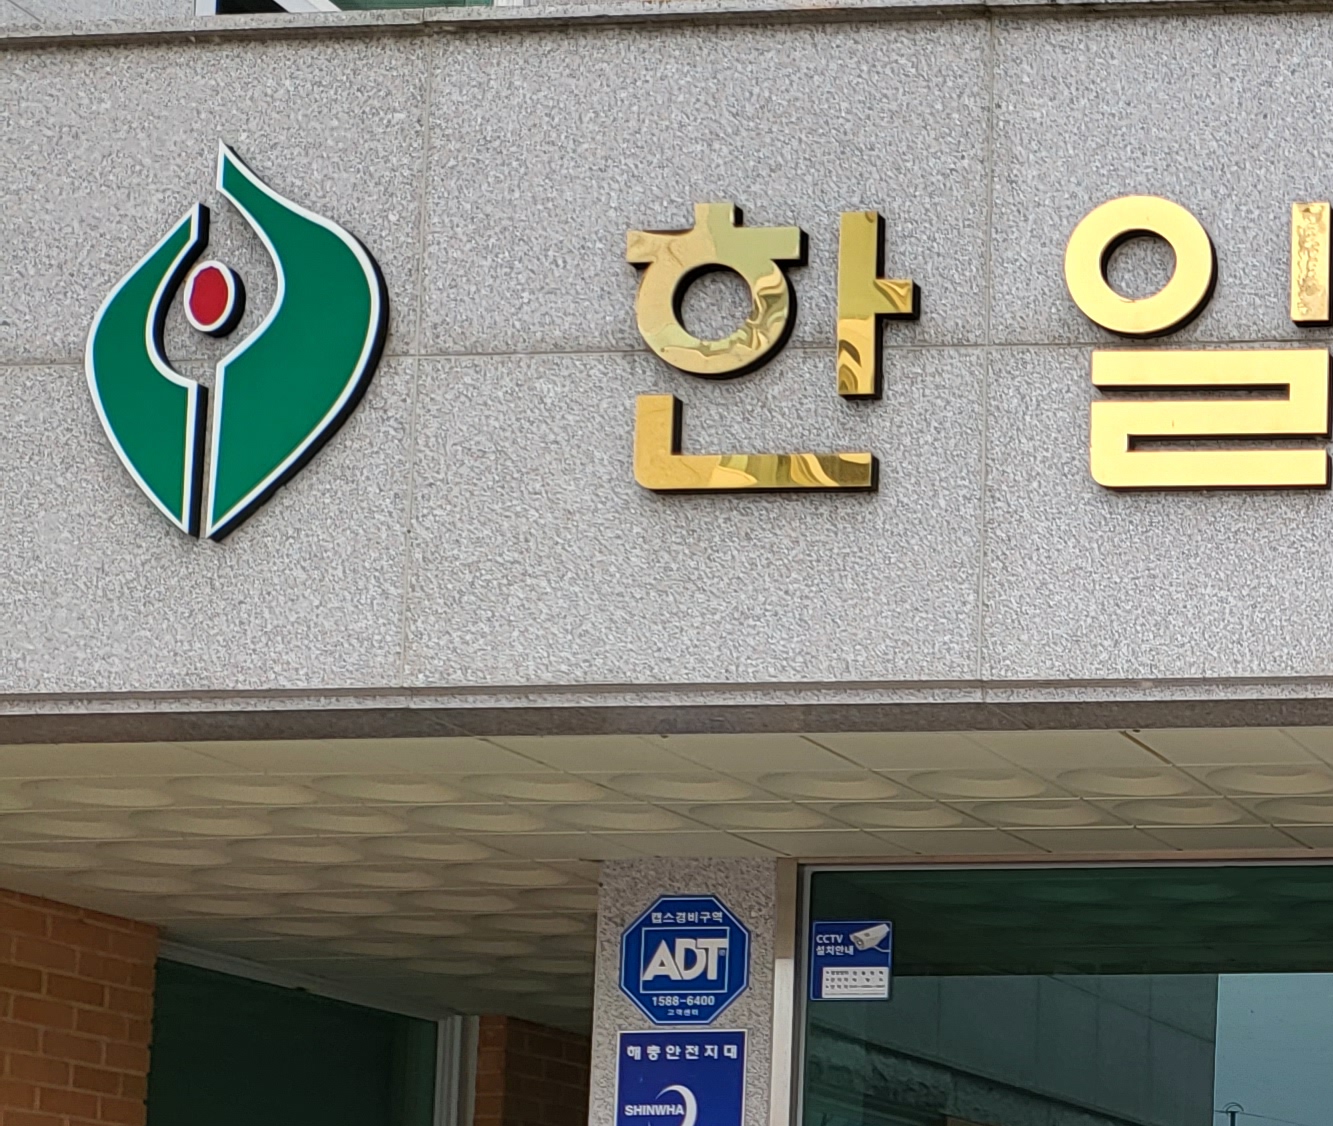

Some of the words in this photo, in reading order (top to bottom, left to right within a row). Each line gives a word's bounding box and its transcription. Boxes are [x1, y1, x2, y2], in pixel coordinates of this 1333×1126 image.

[651, 911, 723, 924] 캡스경비구역
[816, 934, 843, 944] CCTV
[816, 945, 855, 956] 설치안내
[642, 938, 729, 981] ADT
[652, 996, 715, 1007] 1588-6400
[627, 1044, 738, 1060] 해충안전지대
[624, 1105, 685, 1117] SHINWHA
